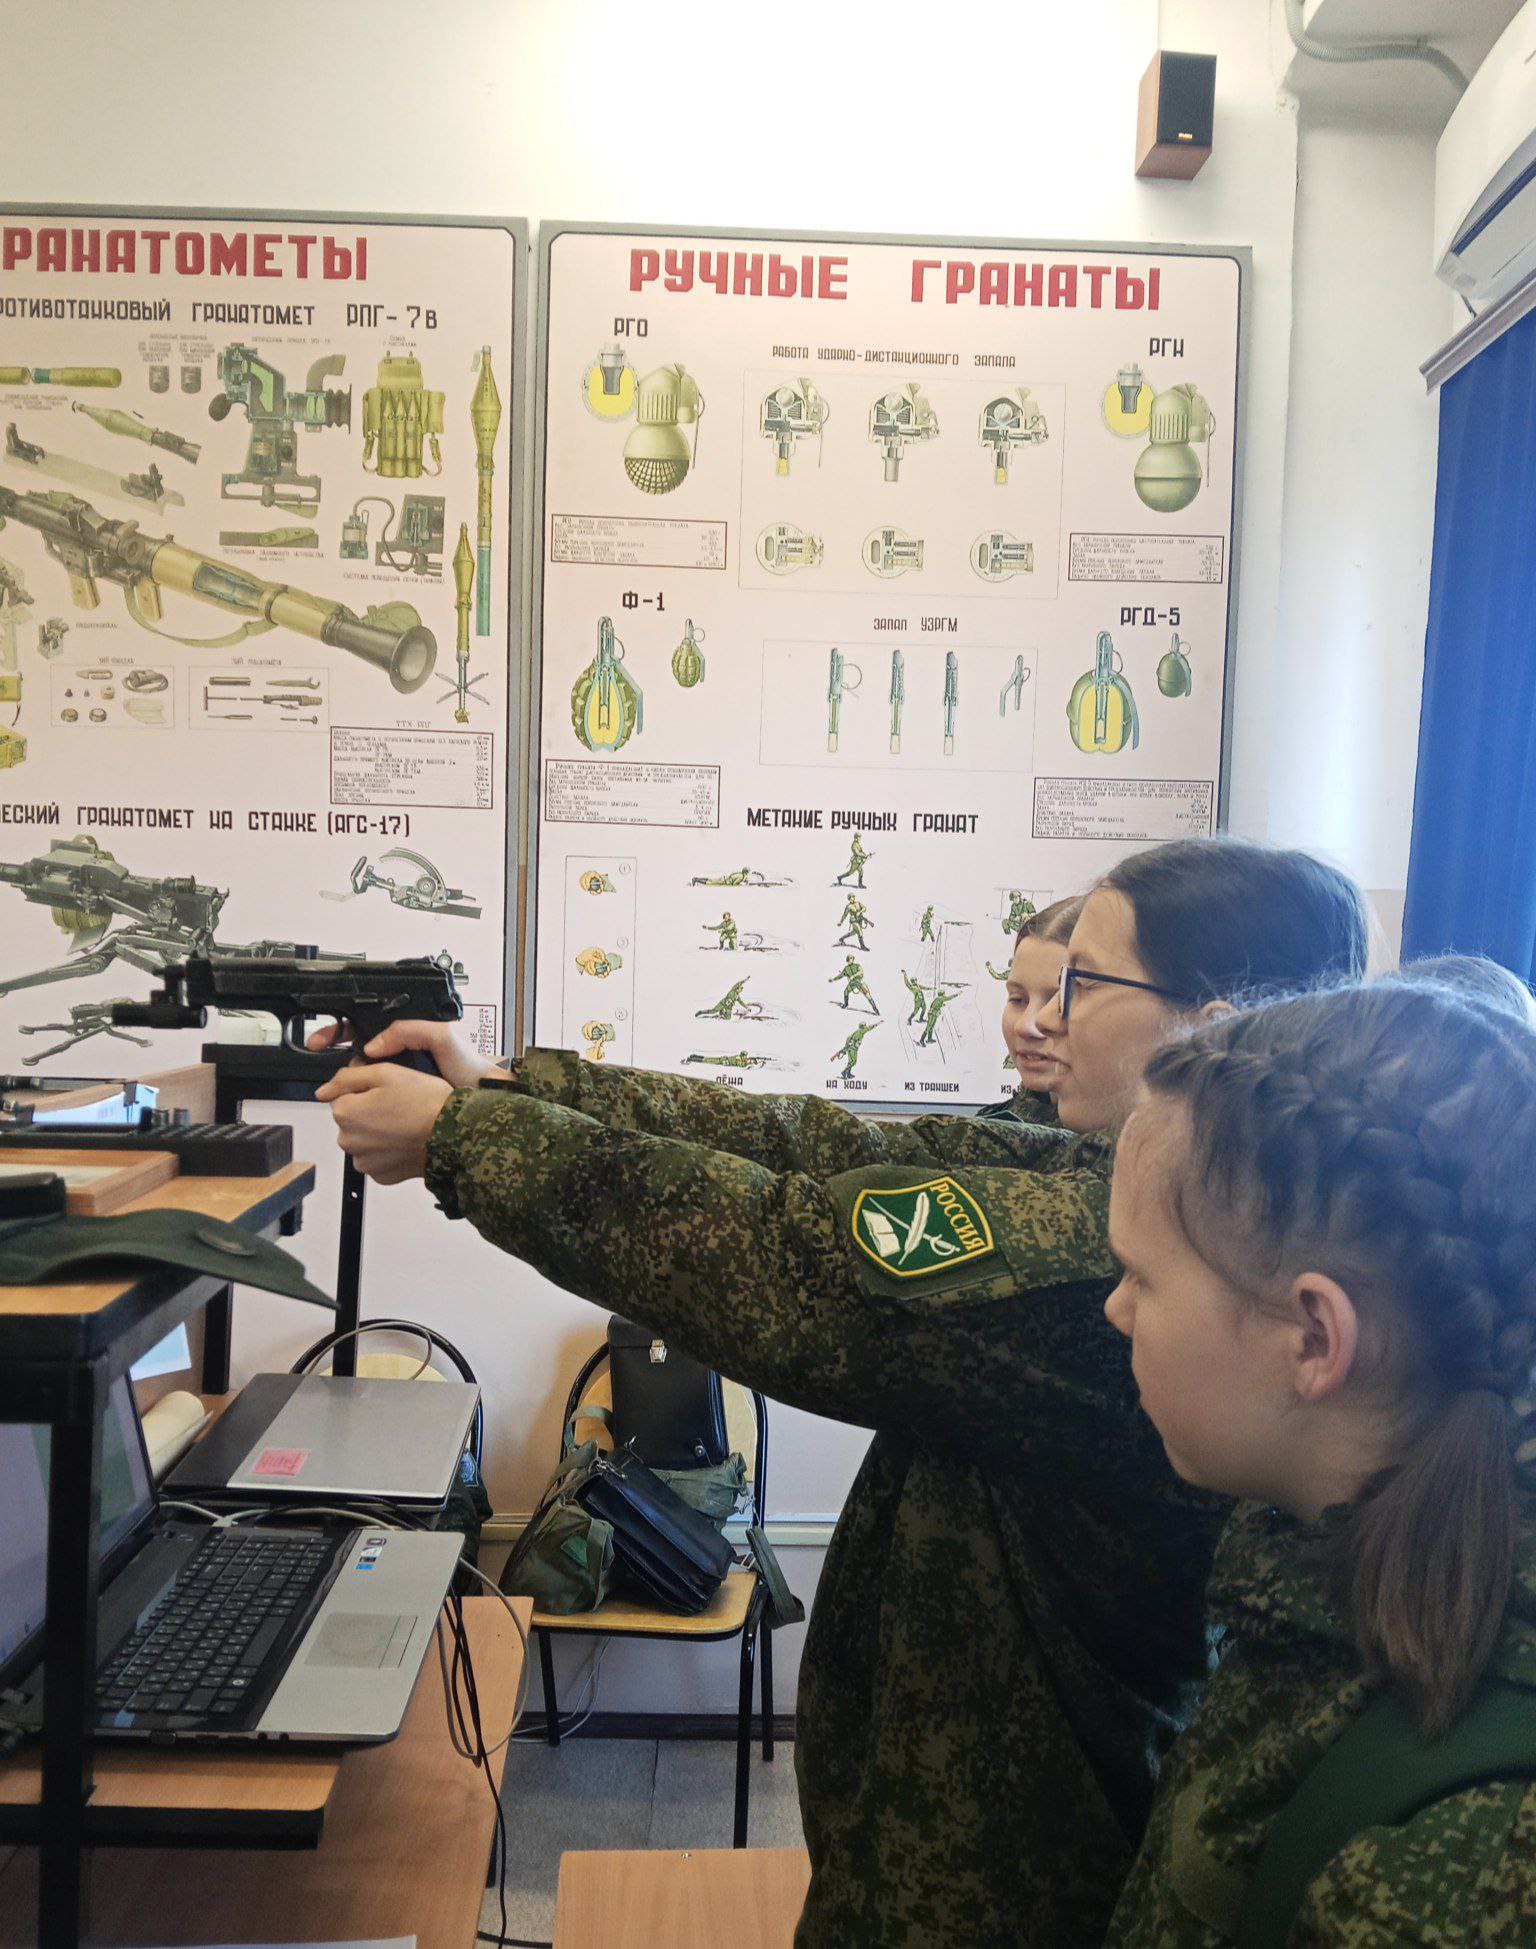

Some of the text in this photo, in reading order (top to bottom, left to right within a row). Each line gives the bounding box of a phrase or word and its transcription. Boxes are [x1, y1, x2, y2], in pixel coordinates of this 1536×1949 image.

[3, 228, 367, 281] РАНАТОМЕТЫ
[630, 248, 1160, 310] РУЧНЫЕ ГРАНАТЫ
[192, 303, 315, 326] ГРАНАТОМЕТ
[614, 317, 648, 337] РГО
[772, 345, 809, 359] РАБОТА
[974, 354, 1016, 368] ЗАПАЛА
[1149, 337, 1184, 358] РГН
[622, 591, 665, 611] Ф-1
[873, 617, 958, 632] ЗАПАЛ УЗРГМ
[1120, 607, 1180, 626] РГД-5
[0, 802, 410, 838] ЕСКИЙ ГРАНАТОМЕТ НА СТАНКЕ (АГС-17)
[747, 808, 979, 834] МЕТАНИЕ РУЧНЫХ ГРАНАТ
[826, 1079, 868, 1091] НА ХОДУ
[904, 1081, 916, 1091] ИЗ
[1001, 1084, 1012, 1094] ИЗ
[929, 1182, 985, 1251] РОССИЯ
